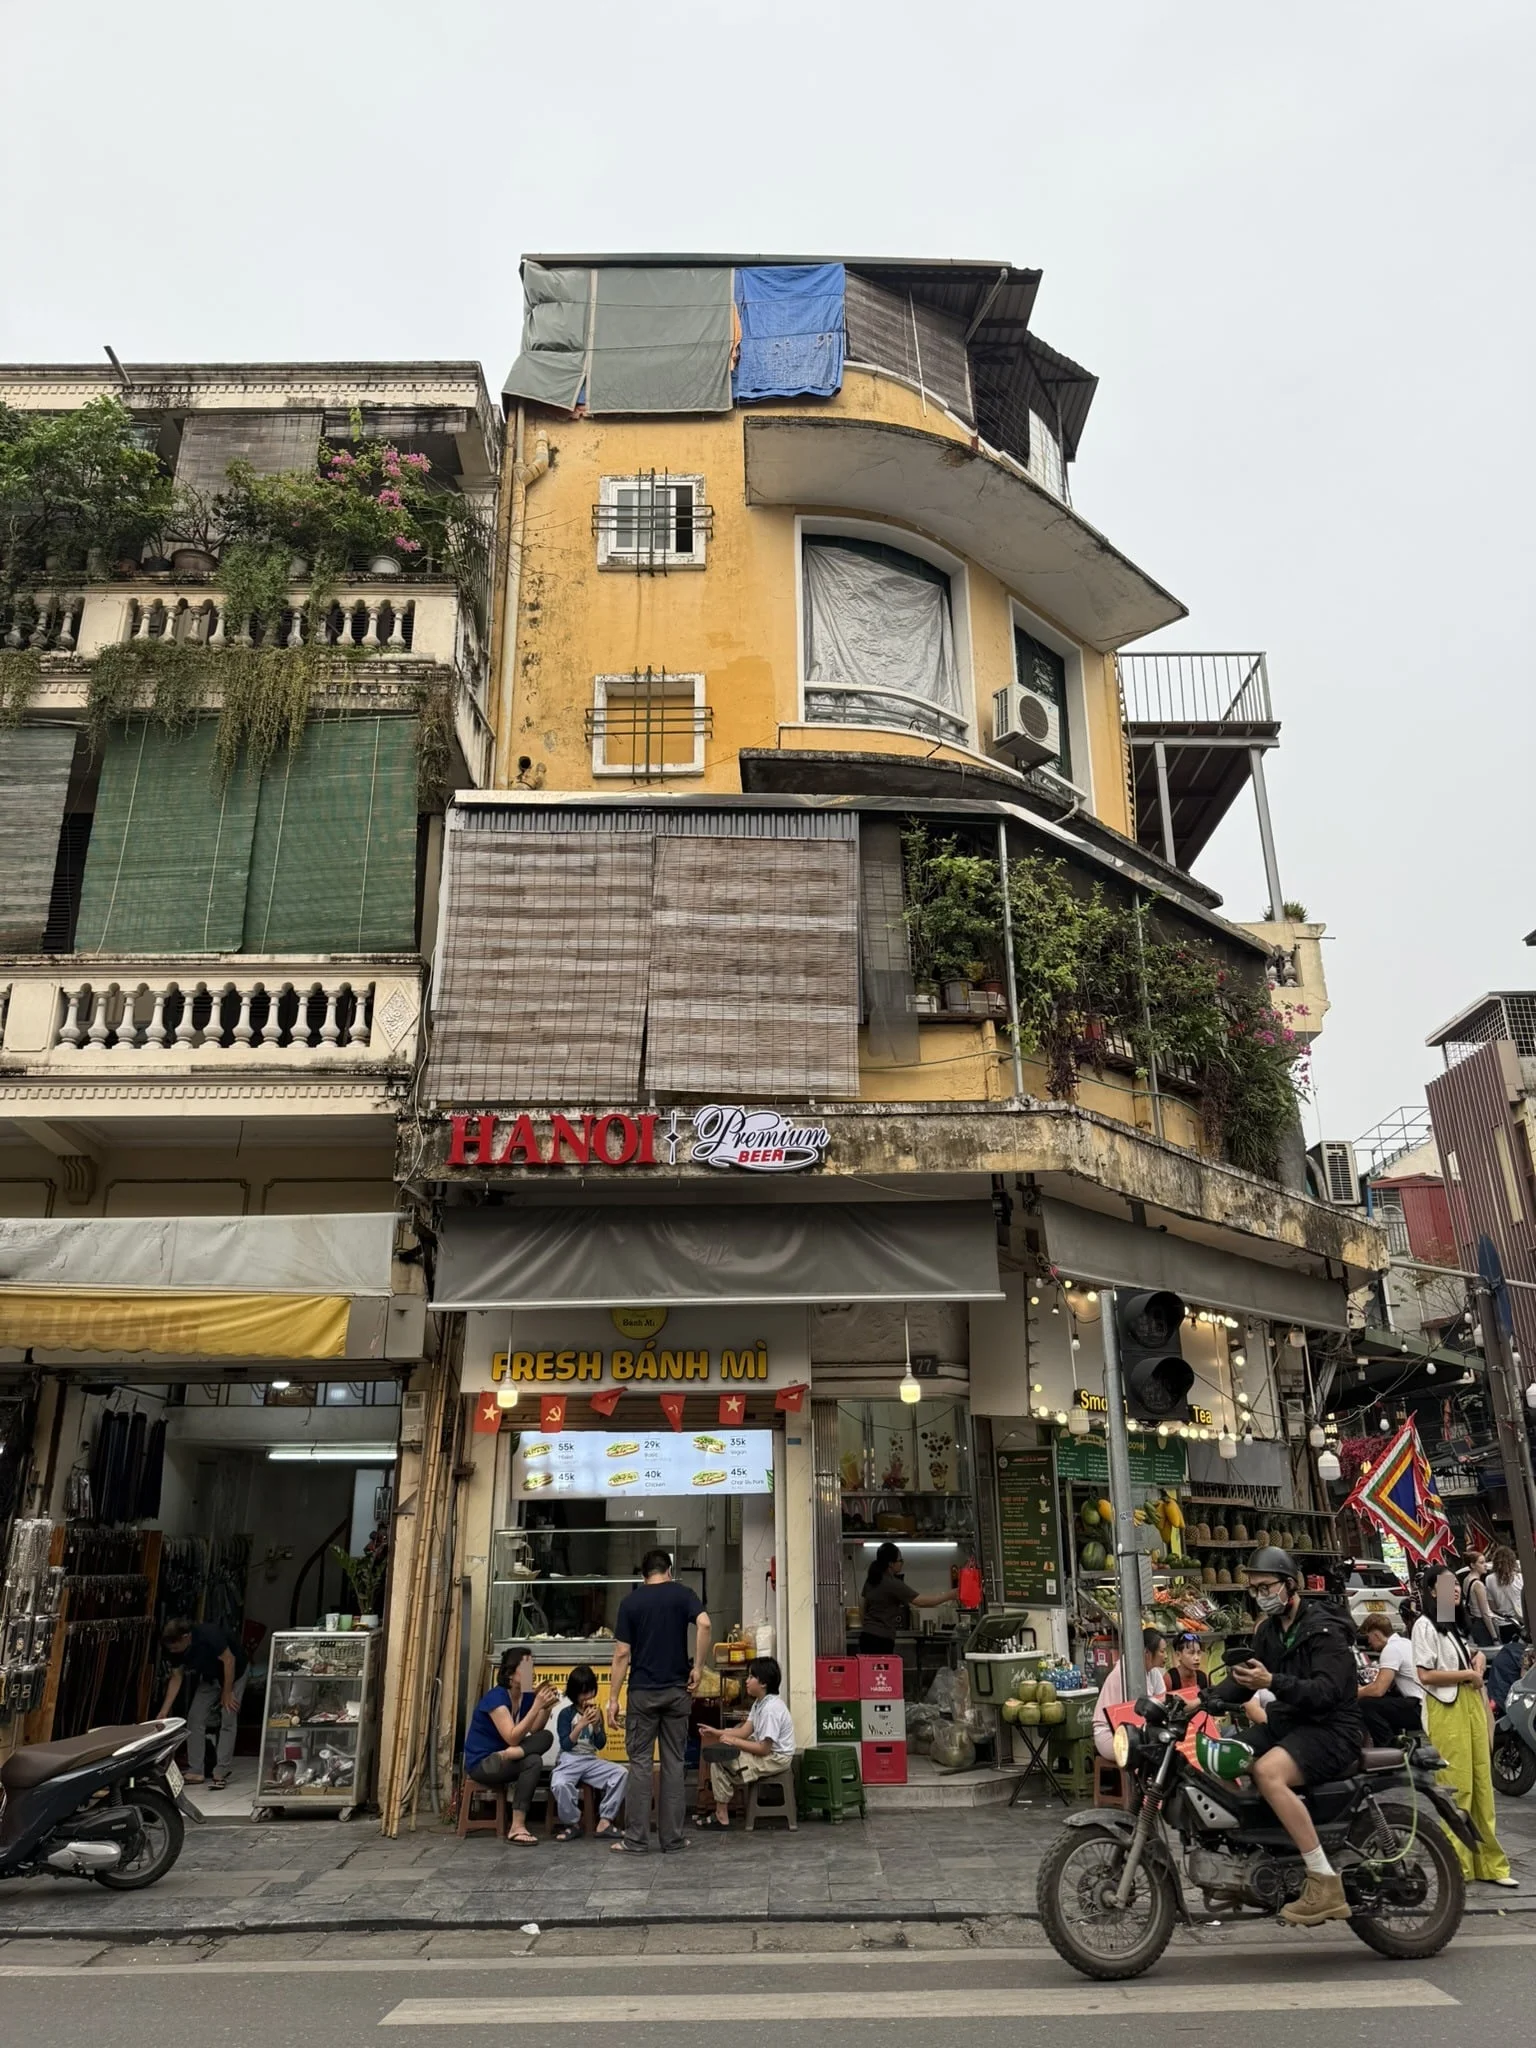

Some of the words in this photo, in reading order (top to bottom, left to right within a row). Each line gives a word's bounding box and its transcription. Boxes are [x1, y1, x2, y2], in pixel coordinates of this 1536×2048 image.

[446, 1113, 659, 1166] HANOI
[693, 1105, 829, 1168] Premium
[737, 1149, 784, 1163] BEER
[491, 1350, 602, 1382] FRESH
[611, 1341, 709, 1382] BÁNH
[720, 1340, 769, 1382] MÌ
[916, 1359, 931, 1373] 77
[1193, 1405, 1212, 1424] Tea
[644, 1440, 661, 1449] 29k
[730, 1438, 746, 1446] 35k
[558, 1443, 574, 1451] 55k
[644, 1470, 662, 1479] 40k
[730, 1468, 748, 1476] 45k
[558, 1473, 575, 1481] 45k
[822, 1721, 855, 1730] SAIGON
